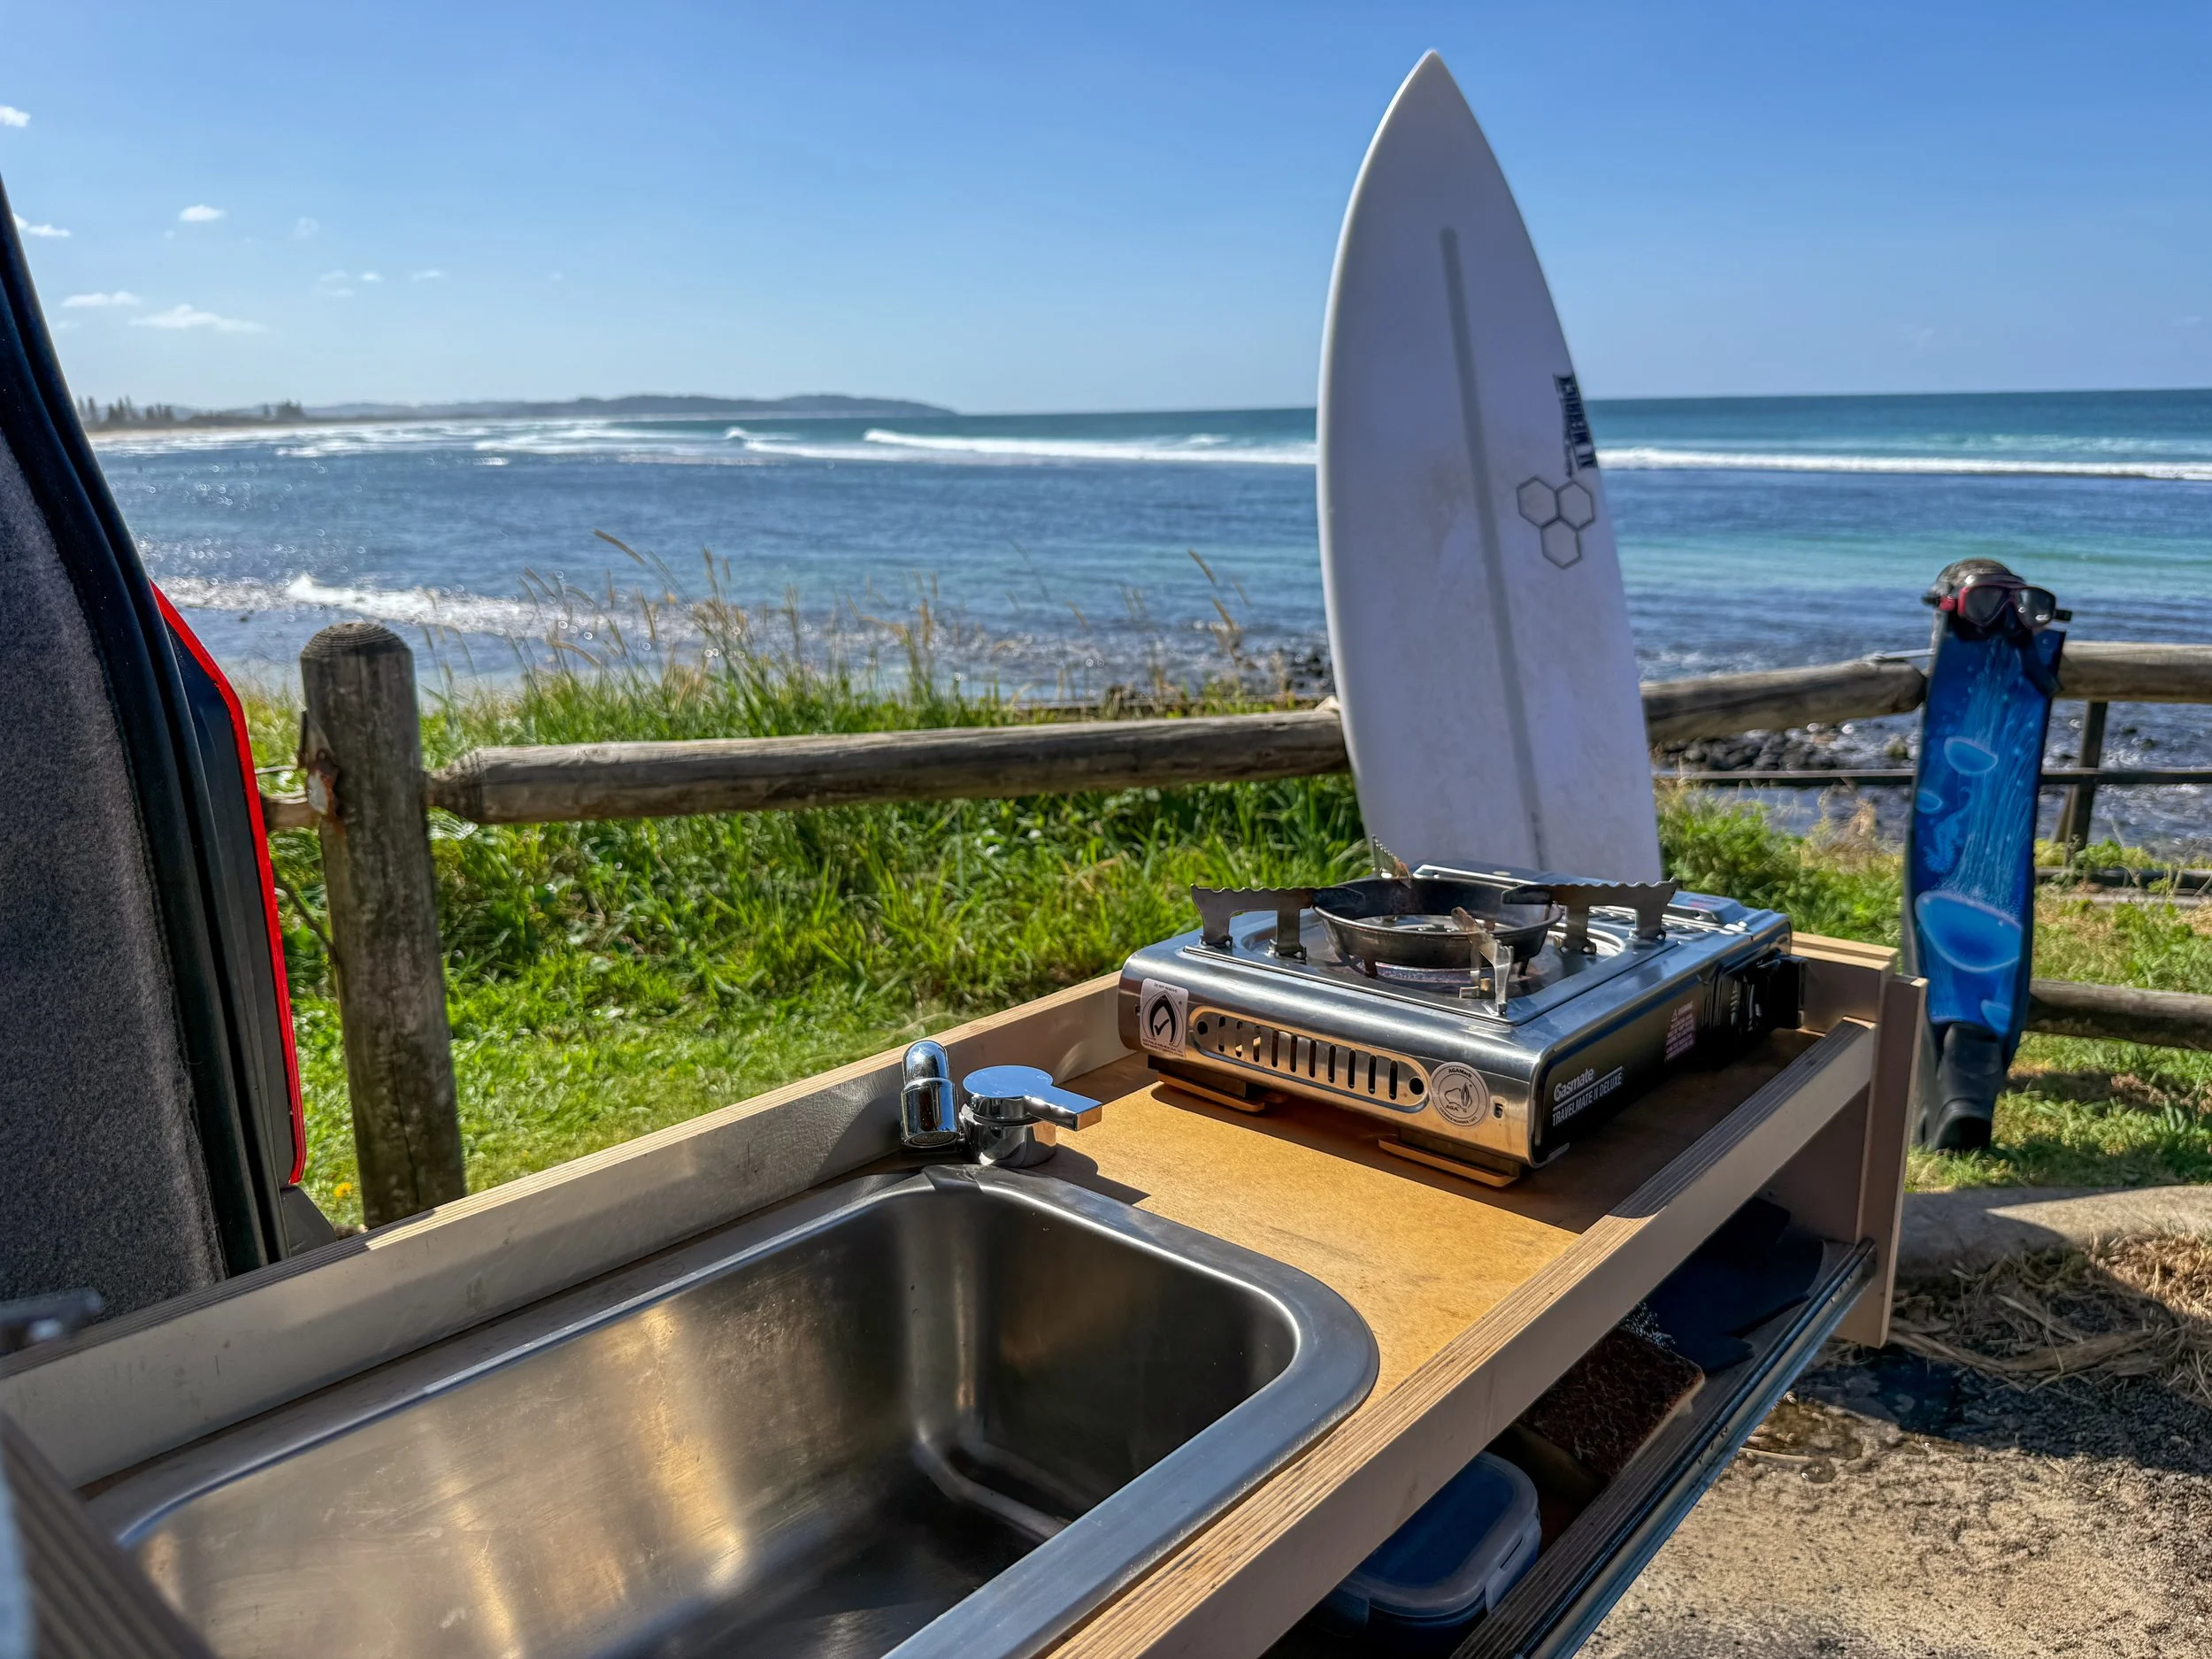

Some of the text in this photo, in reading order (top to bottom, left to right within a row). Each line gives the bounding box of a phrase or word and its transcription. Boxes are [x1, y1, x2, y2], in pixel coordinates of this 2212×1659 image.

[1552, 1072, 1622, 1126] TRAVELMATE II DELUXE
[1553, 1067, 1594, 1102] Gasmate
